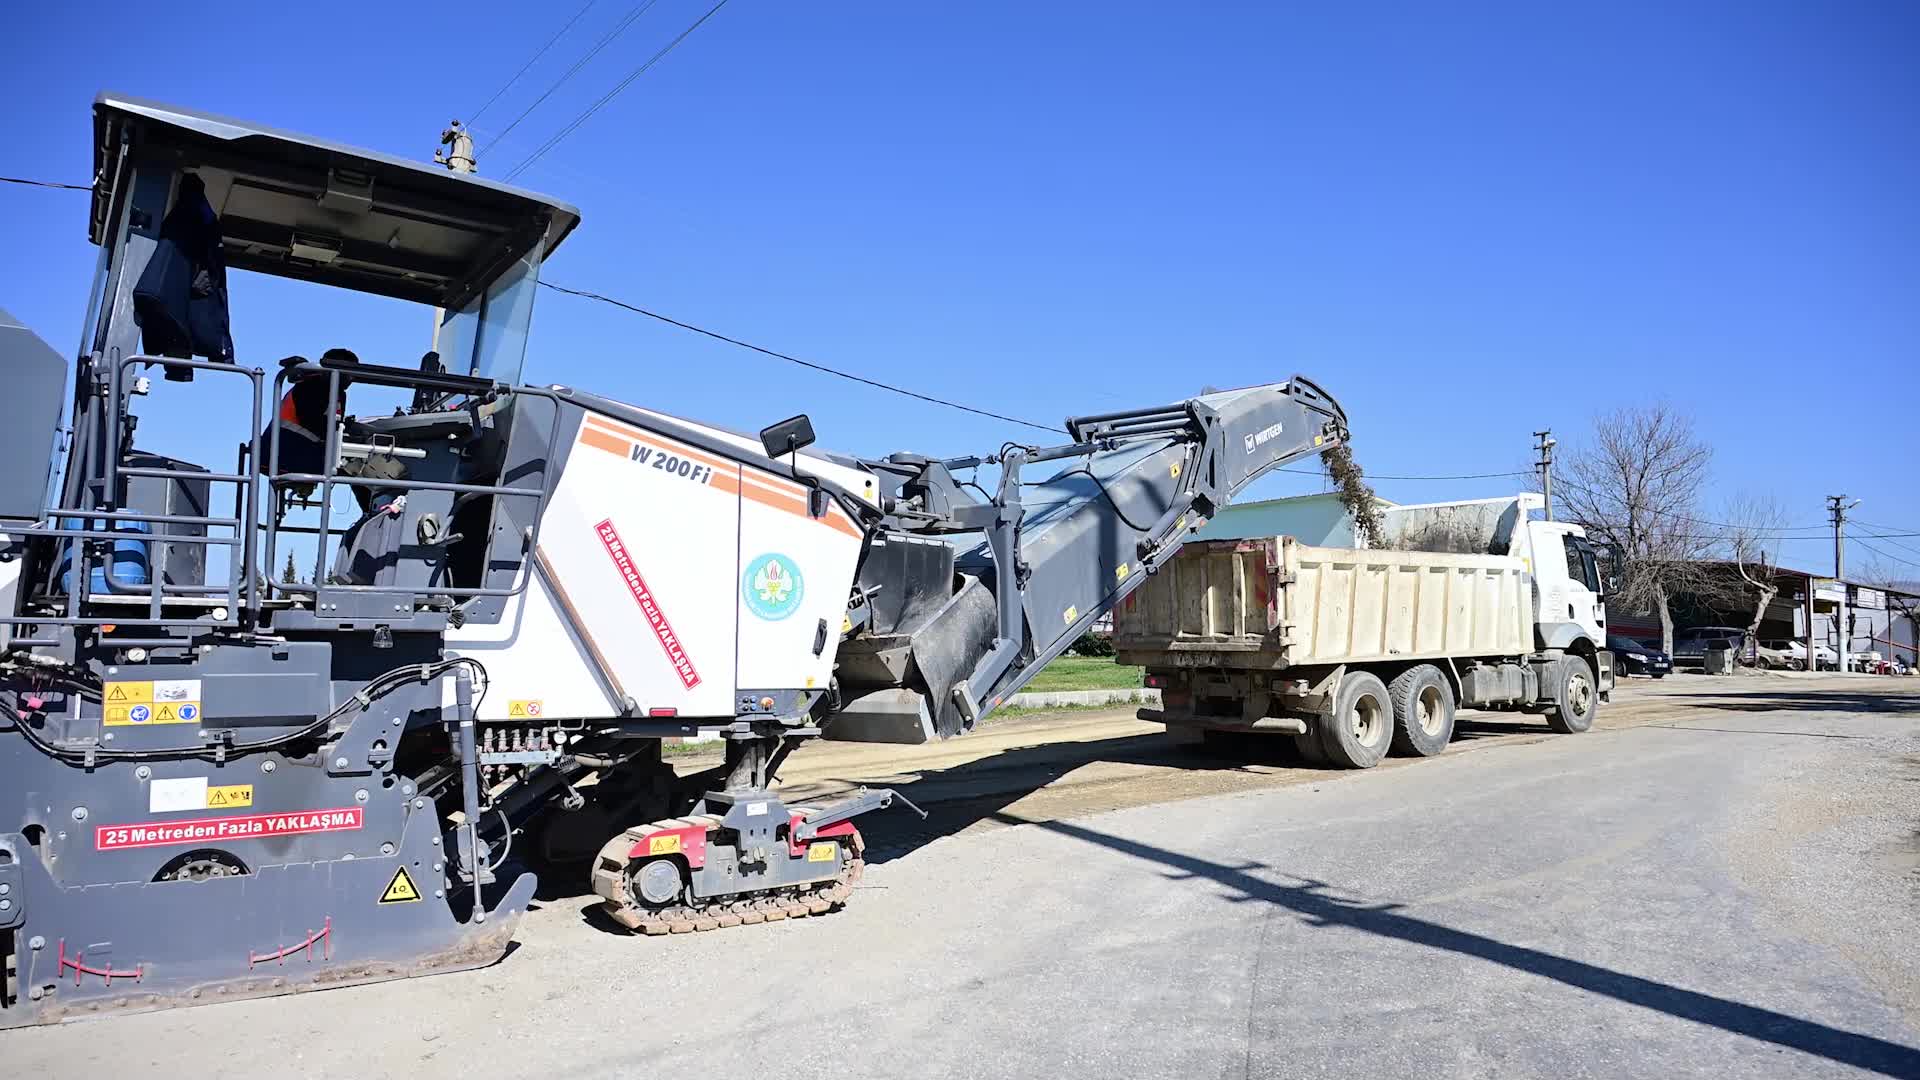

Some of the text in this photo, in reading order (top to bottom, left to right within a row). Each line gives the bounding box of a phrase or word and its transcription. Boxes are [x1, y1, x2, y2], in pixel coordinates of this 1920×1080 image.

[1254, 421, 1283, 446] WIRTGEN
[631, 444, 653, 464] W
[600, 526, 696, 684] 25 Metreden Fazla YAKLAŞMA
[105, 812, 356, 845] 25 Metreden Fazla YAKLAŞMA
